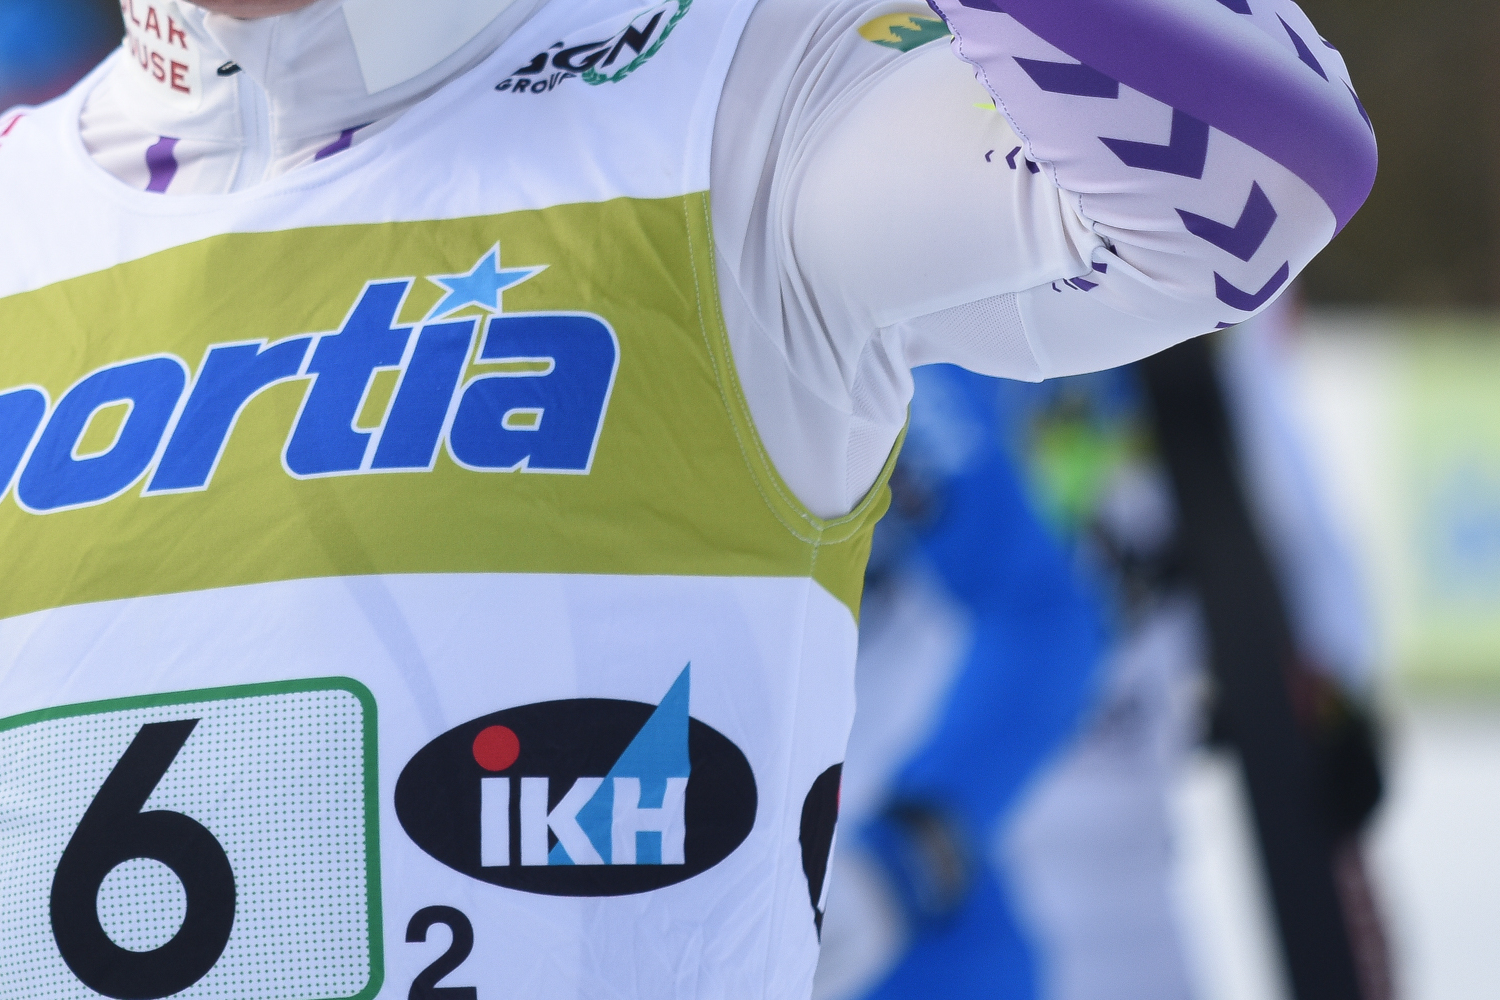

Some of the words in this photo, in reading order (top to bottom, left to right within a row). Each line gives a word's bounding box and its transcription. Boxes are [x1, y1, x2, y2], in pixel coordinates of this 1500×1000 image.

[130, 38, 192, 95] USE
[49, 717, 236, 1000] 6
[404, 904, 478, 1000] 2
